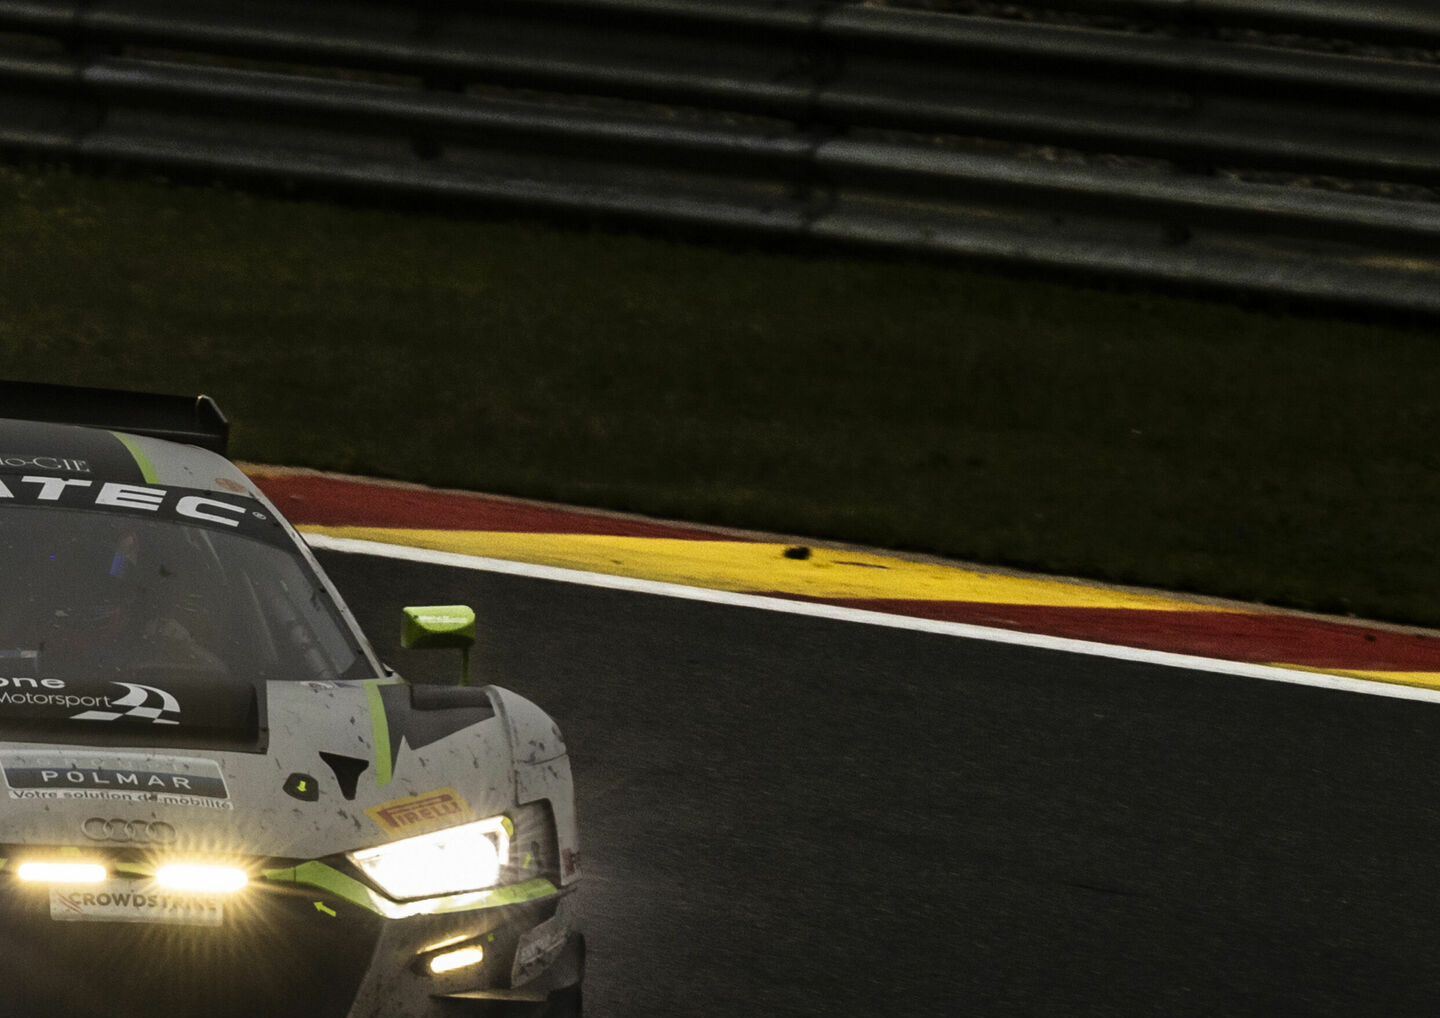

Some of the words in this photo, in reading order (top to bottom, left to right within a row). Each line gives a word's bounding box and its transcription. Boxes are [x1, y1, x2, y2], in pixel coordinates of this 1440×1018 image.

[40, 769, 192, 790] POLMAR
[12, 789, 58, 800] Votre
[63, 790, 133, 801] solution
[376, 793, 460, 829] PIRELLI
